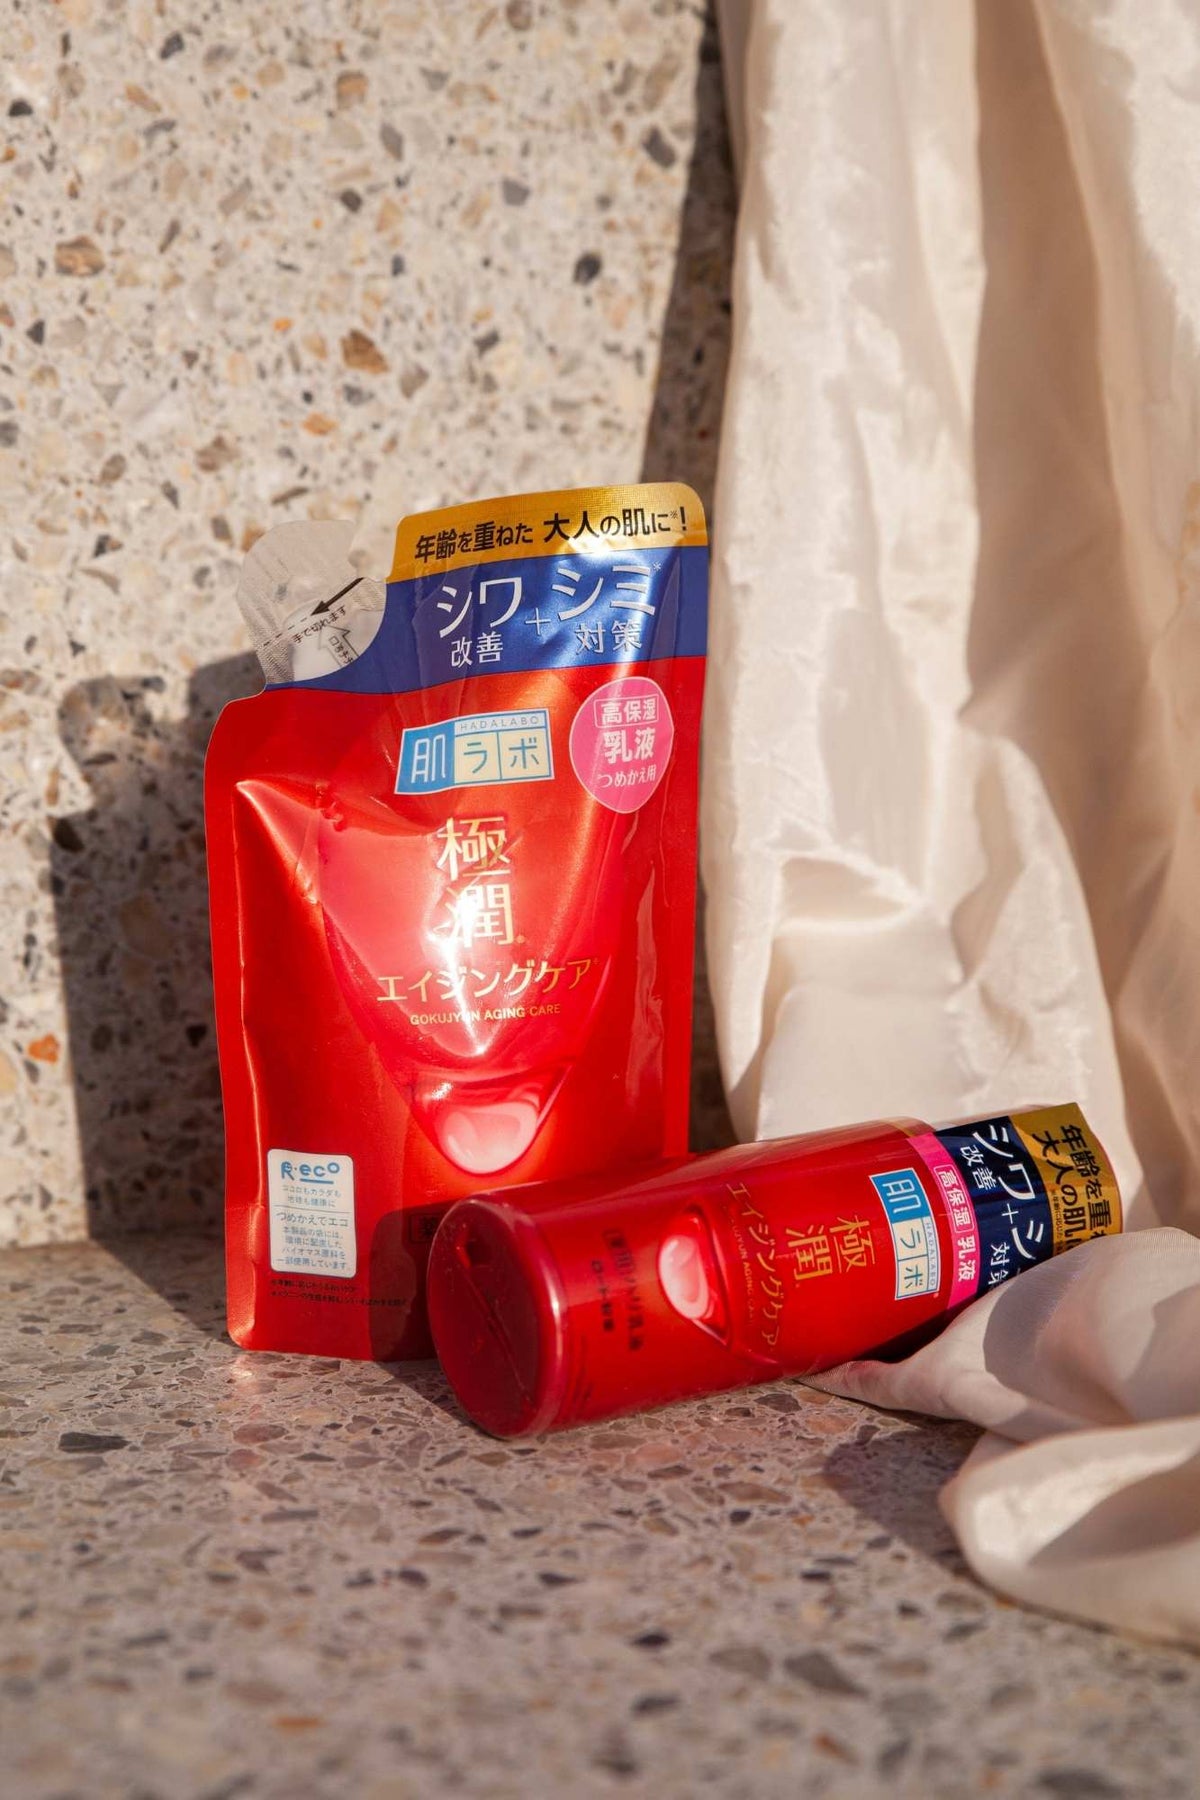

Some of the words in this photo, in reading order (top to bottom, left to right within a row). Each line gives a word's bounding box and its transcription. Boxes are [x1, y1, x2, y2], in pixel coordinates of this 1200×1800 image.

[414, 520, 534, 563] 年齢を重ねた
[451, 632, 503, 668] 改善
[575, 620, 642, 655] 対策
[460, 715, 540, 732] HADALABO
[602, 698, 657, 726] 高保湿
[411, 734, 540, 784] 肌ラボ
[603, 727, 656, 765] 乳液
[597, 766, 657, 789] つめかえ用
[410, 1010, 480, 1026] GOKUJYN
[484, 1006, 525, 1021] AGING
[529, 1003, 562, 1017] CARE
[959, 1145, 997, 1190] 改善
[276, 1212, 349, 1227] つめかえでエコ
[882, 1178, 923, 1290] 肌ラボ
[938, 1170, 971, 1227] 高保湿
[957, 1234, 976, 1283] 乳液
[726, 1182, 784, 1346] エイジングケア
